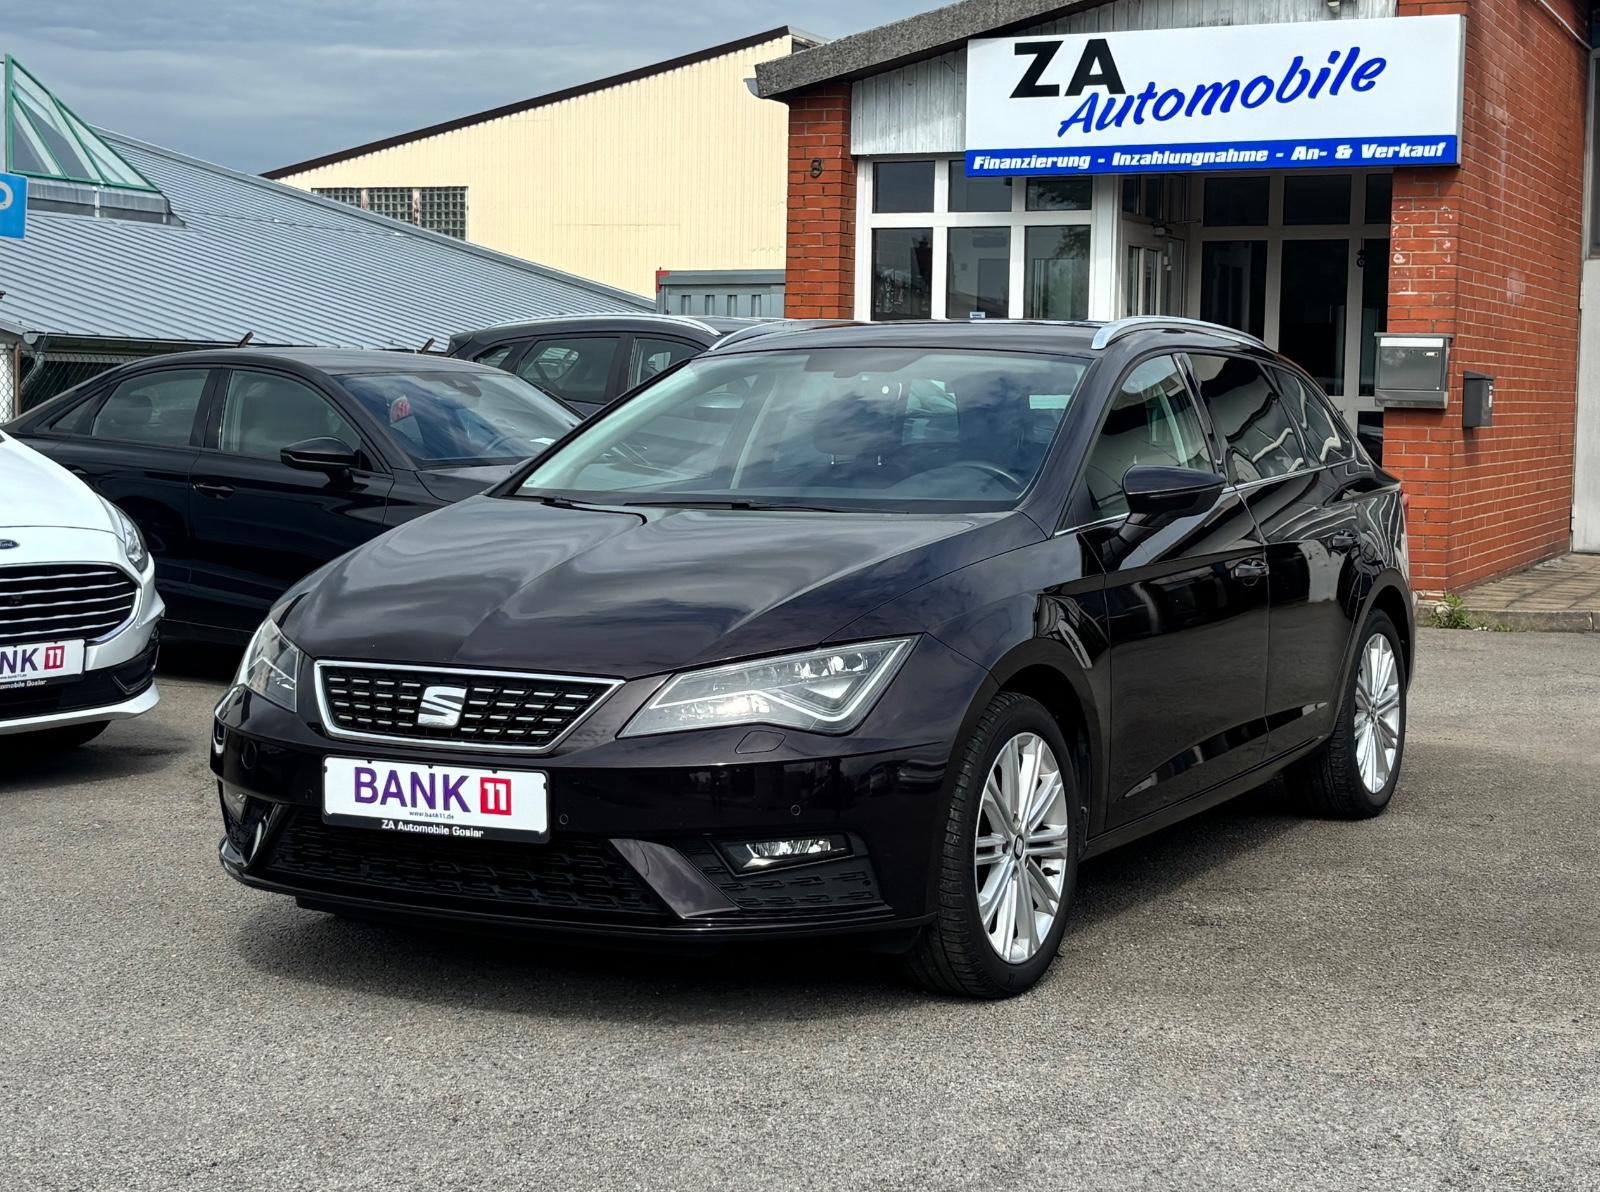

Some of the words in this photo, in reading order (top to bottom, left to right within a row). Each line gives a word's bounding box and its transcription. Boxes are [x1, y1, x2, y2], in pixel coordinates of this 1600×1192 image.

[1009, 38, 1126, 98] ZA
[1057, 46, 1387, 138] Automobile
[973, 154, 1091, 170] Finanzierung
[1112, 149, 1268, 167] Inzahlungnahme
[1290, 146, 1327, 161] An-
[1335, 144, 1353, 160] &
[1361, 142, 1447, 159] Verkauf
[46, 648, 63, 667] 11
[354, 766, 471, 813] BANK
[483, 780, 508, 812] 11
[381, 820, 395, 829] ZA
[397, 821, 450, 835] Automobile
[452, 826, 484, 838] Goslar
